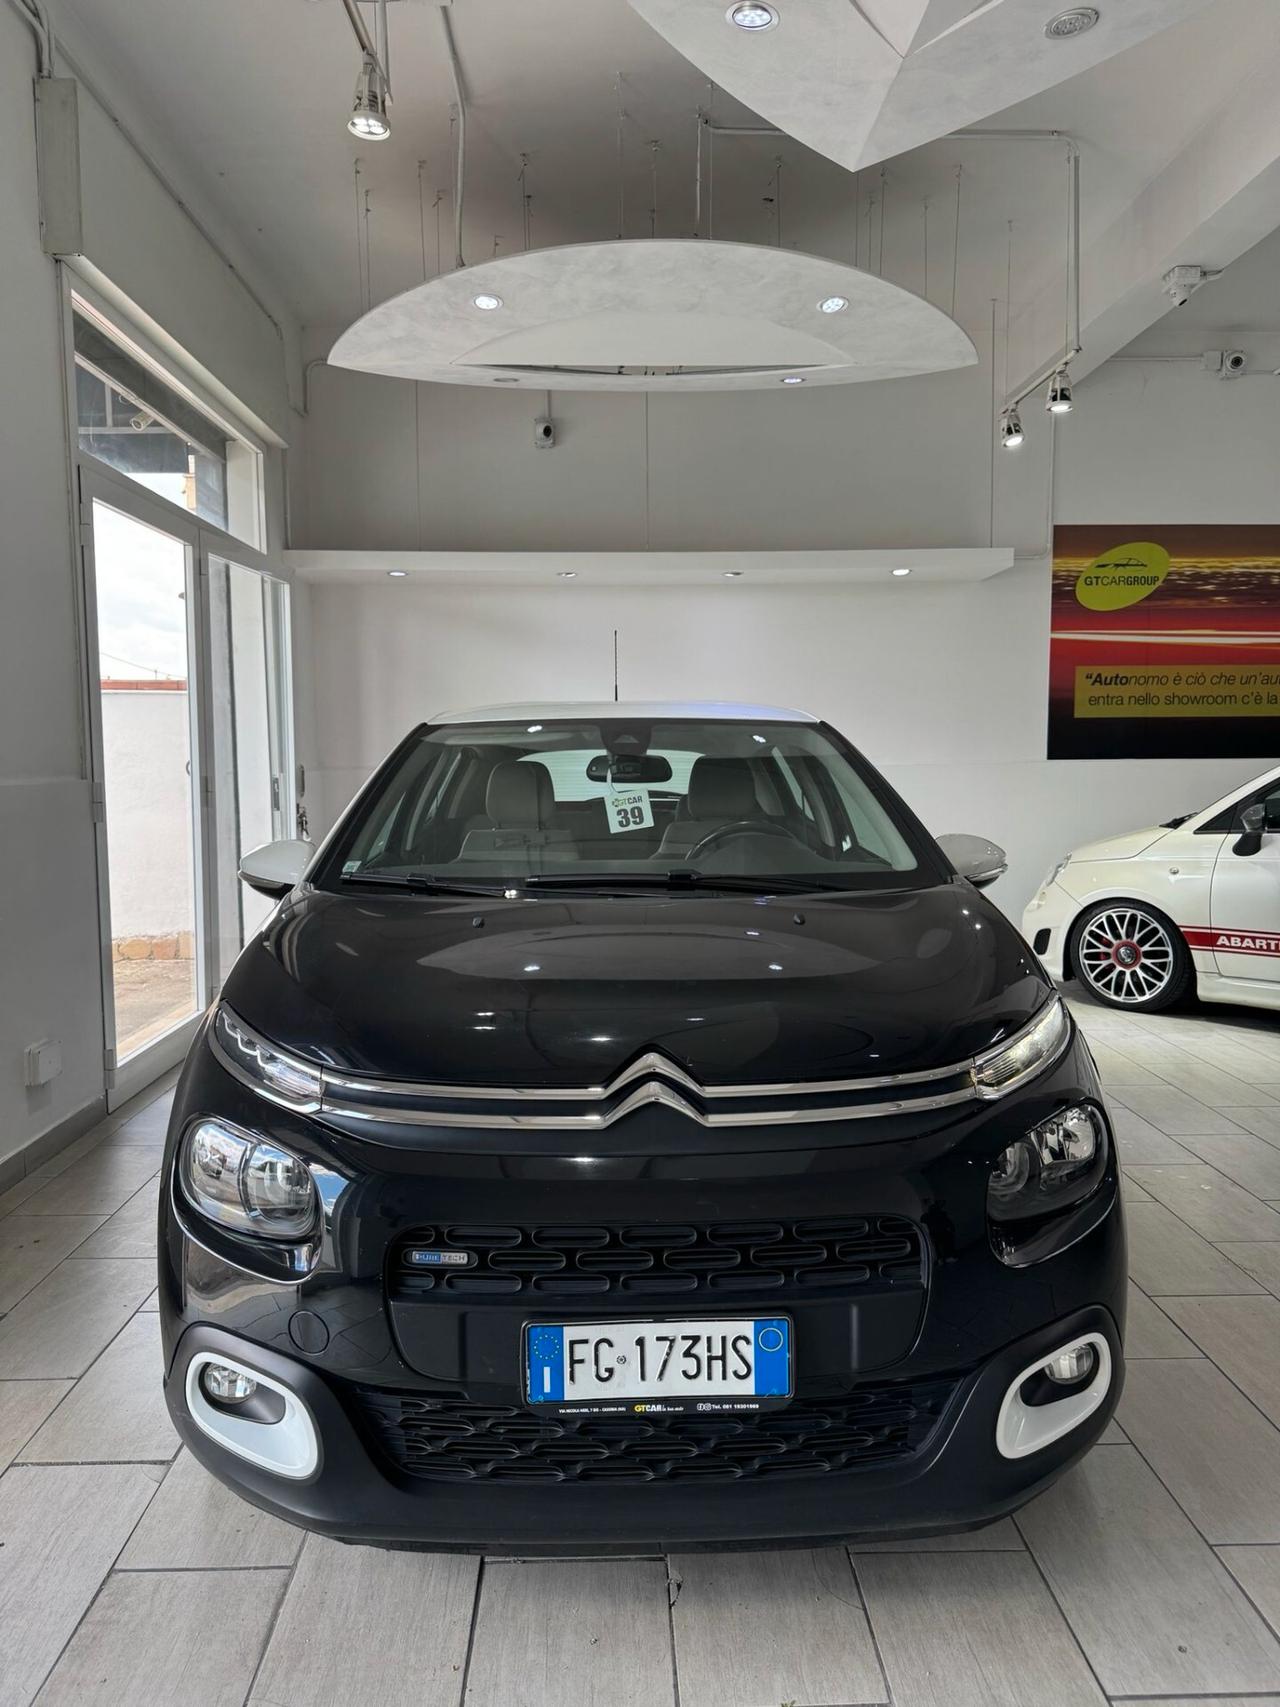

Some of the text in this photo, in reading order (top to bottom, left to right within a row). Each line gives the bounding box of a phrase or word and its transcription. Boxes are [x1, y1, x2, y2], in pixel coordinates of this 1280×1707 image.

[1084, 576, 1160, 587] GTCARGROUP
[1172, 672, 1183, 686] è
[1185, 672, 1206, 686] ciò
[1210, 672, 1236, 686] che
[1240, 672, 1280, 686] un'au
[1088, 691, 1278, 706] entra nello showroom c'è la
[616, 806, 645, 828] 39
[1216, 935, 1280, 951] ABART
[634, 1404, 662, 1412] GTCAR
